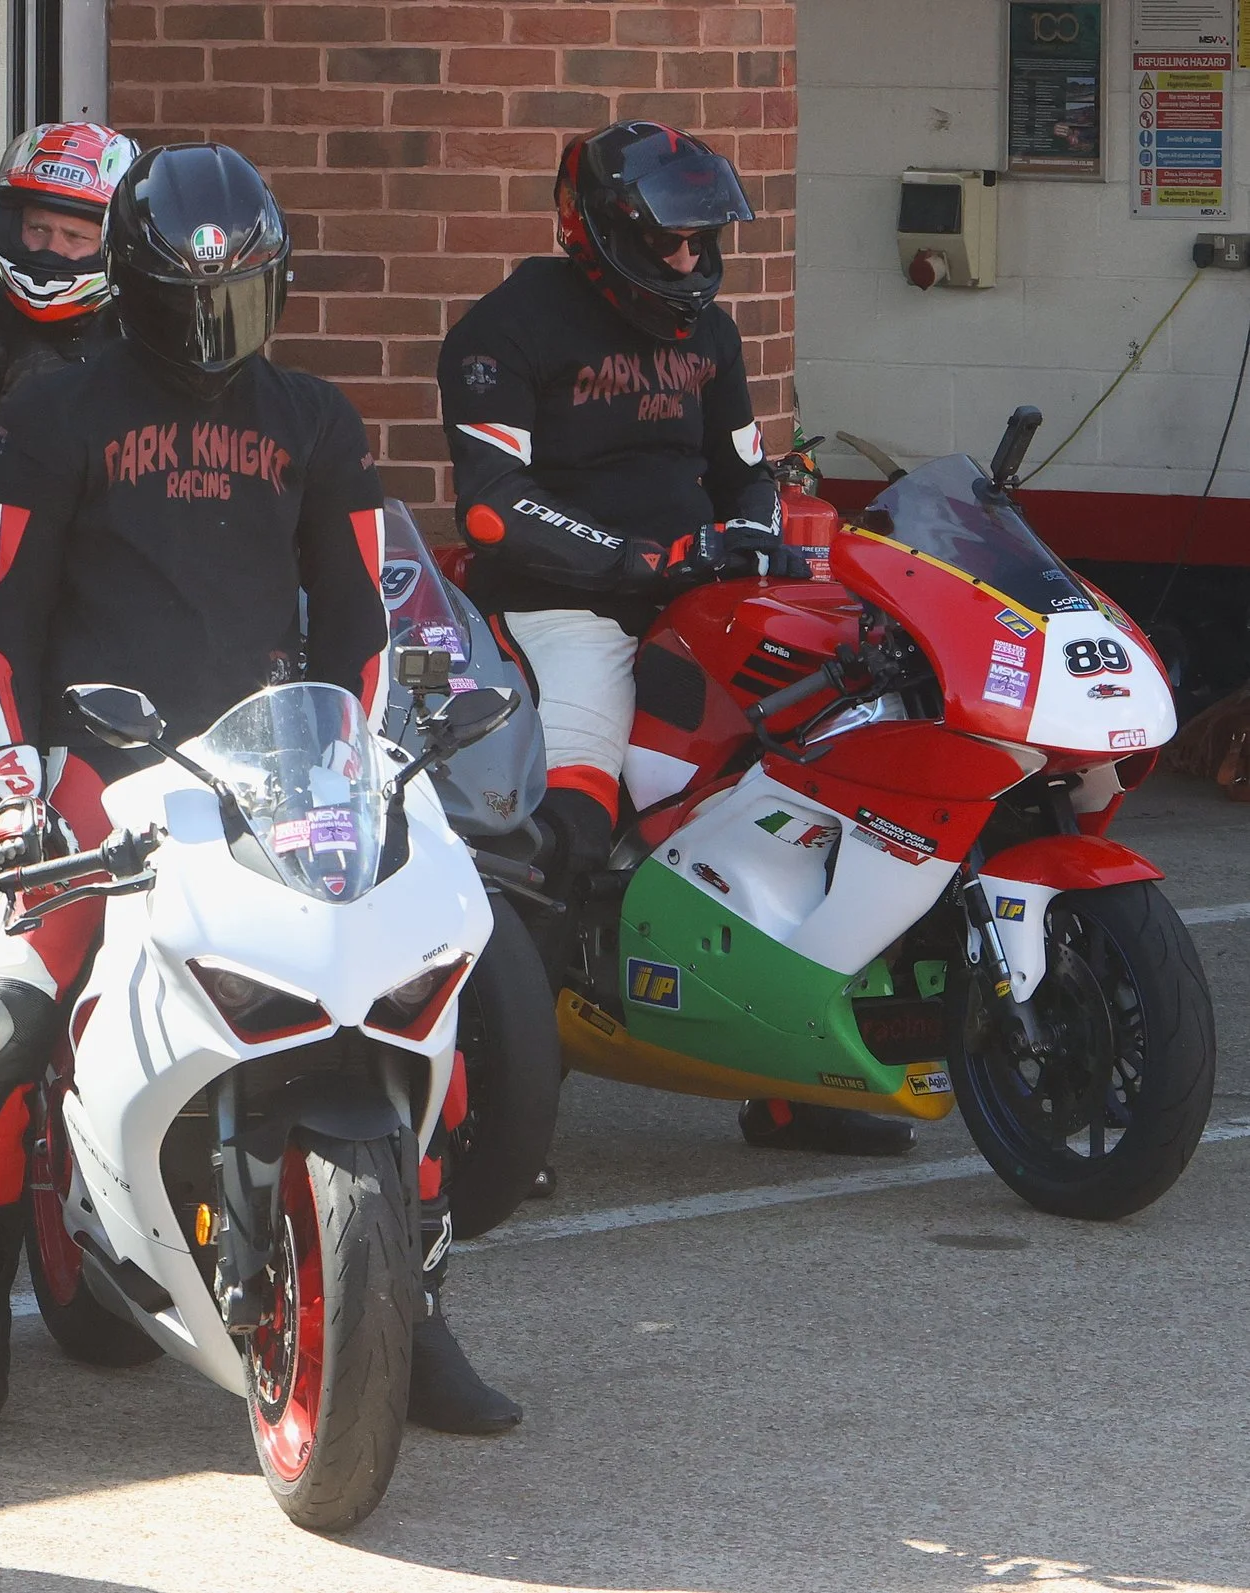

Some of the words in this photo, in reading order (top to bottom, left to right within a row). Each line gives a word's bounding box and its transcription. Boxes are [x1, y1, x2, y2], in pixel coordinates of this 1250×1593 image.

[1138, 57, 1188, 67] REFUELLING
[1190, 58, 1226, 67] HAZARD
[41, 164, 85, 182] SHOEI
[199, 246, 222, 258] agv
[573, 352, 650, 407] DARK
[638, 393, 684, 422] RACING
[166, 470, 231, 503] RACING
[512, 498, 624, 549] DAINESE
[1051, 596, 1089, 607] GoPro
[423, 627, 453, 636] MSVT
[763, 642, 790, 658] aprilia
[994, 640, 1011, 648] NOISE
[1012, 643, 1027, 651] TEST
[994, 645, 1025, 657] PASSED
[1063, 637, 1132, 678] 89
[991, 663, 1028, 680] MSVT
[1111, 729, 1146, 747] GIVI
[306, 810, 350, 822] MSVT
[311, 821, 334, 829] Brands
[875, 816, 926, 844] TECNOLOGIA
[868, 820, 904, 841] REPARTO
[905, 839, 934, 853] CORSE
[422, 942, 449, 962] DUCATI
[928, 1076, 948, 1089] Agip
